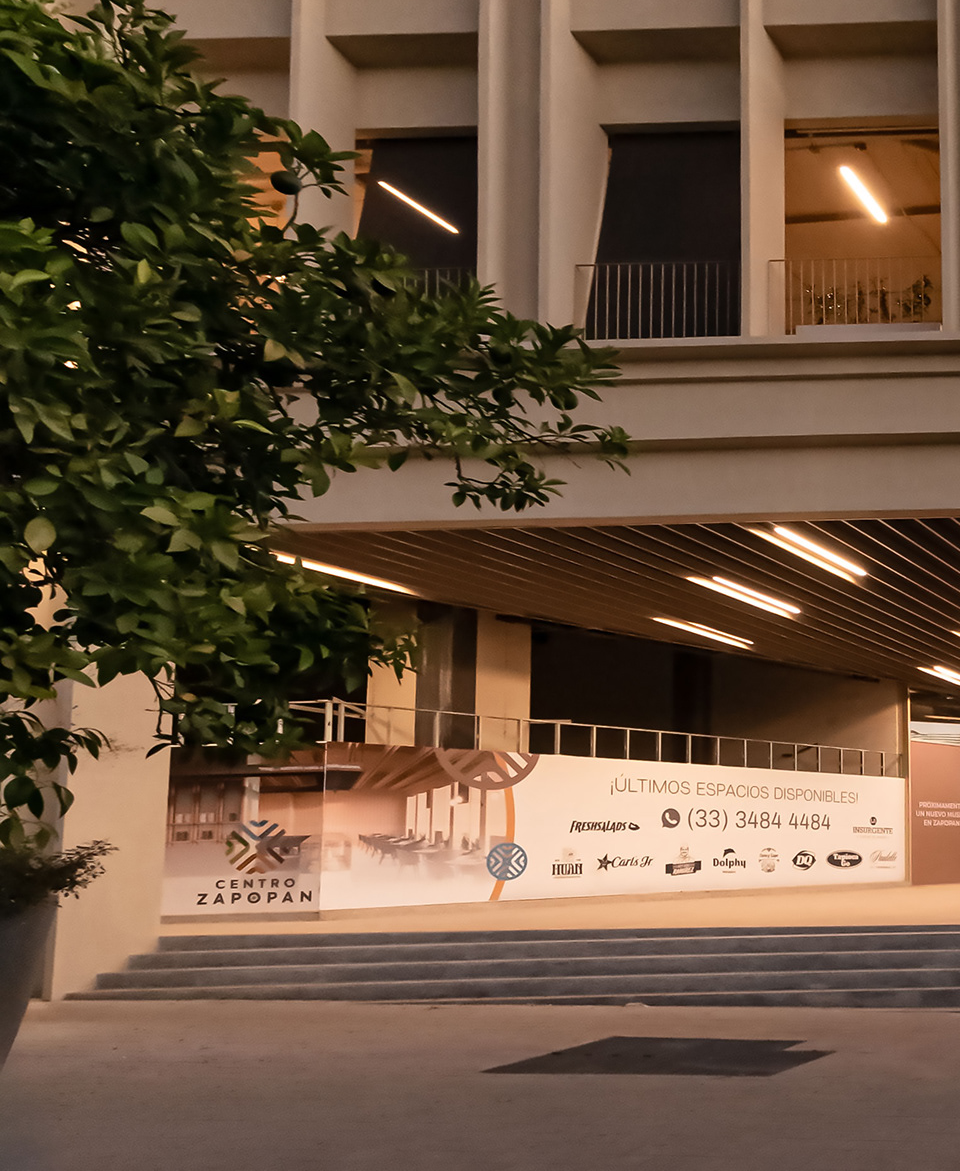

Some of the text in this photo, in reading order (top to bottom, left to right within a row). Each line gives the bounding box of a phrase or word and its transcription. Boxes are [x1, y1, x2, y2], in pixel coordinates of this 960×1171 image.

[610, 773, 858, 804] ¡ÚLTIMOS ESPACIOS DISPONIBLES!
[688, 808, 831, 831] (33) 3484 4484
[933, 819, 960, 827] ZAPOPAN
[852, 826, 893, 834] INSURGENTE
[713, 858, 747, 869] Dolphy
[796, 855, 813, 867] DQ
[215, 878, 296, 890] CENTRO
[196, 890, 313, 906] ZAPOPAN
